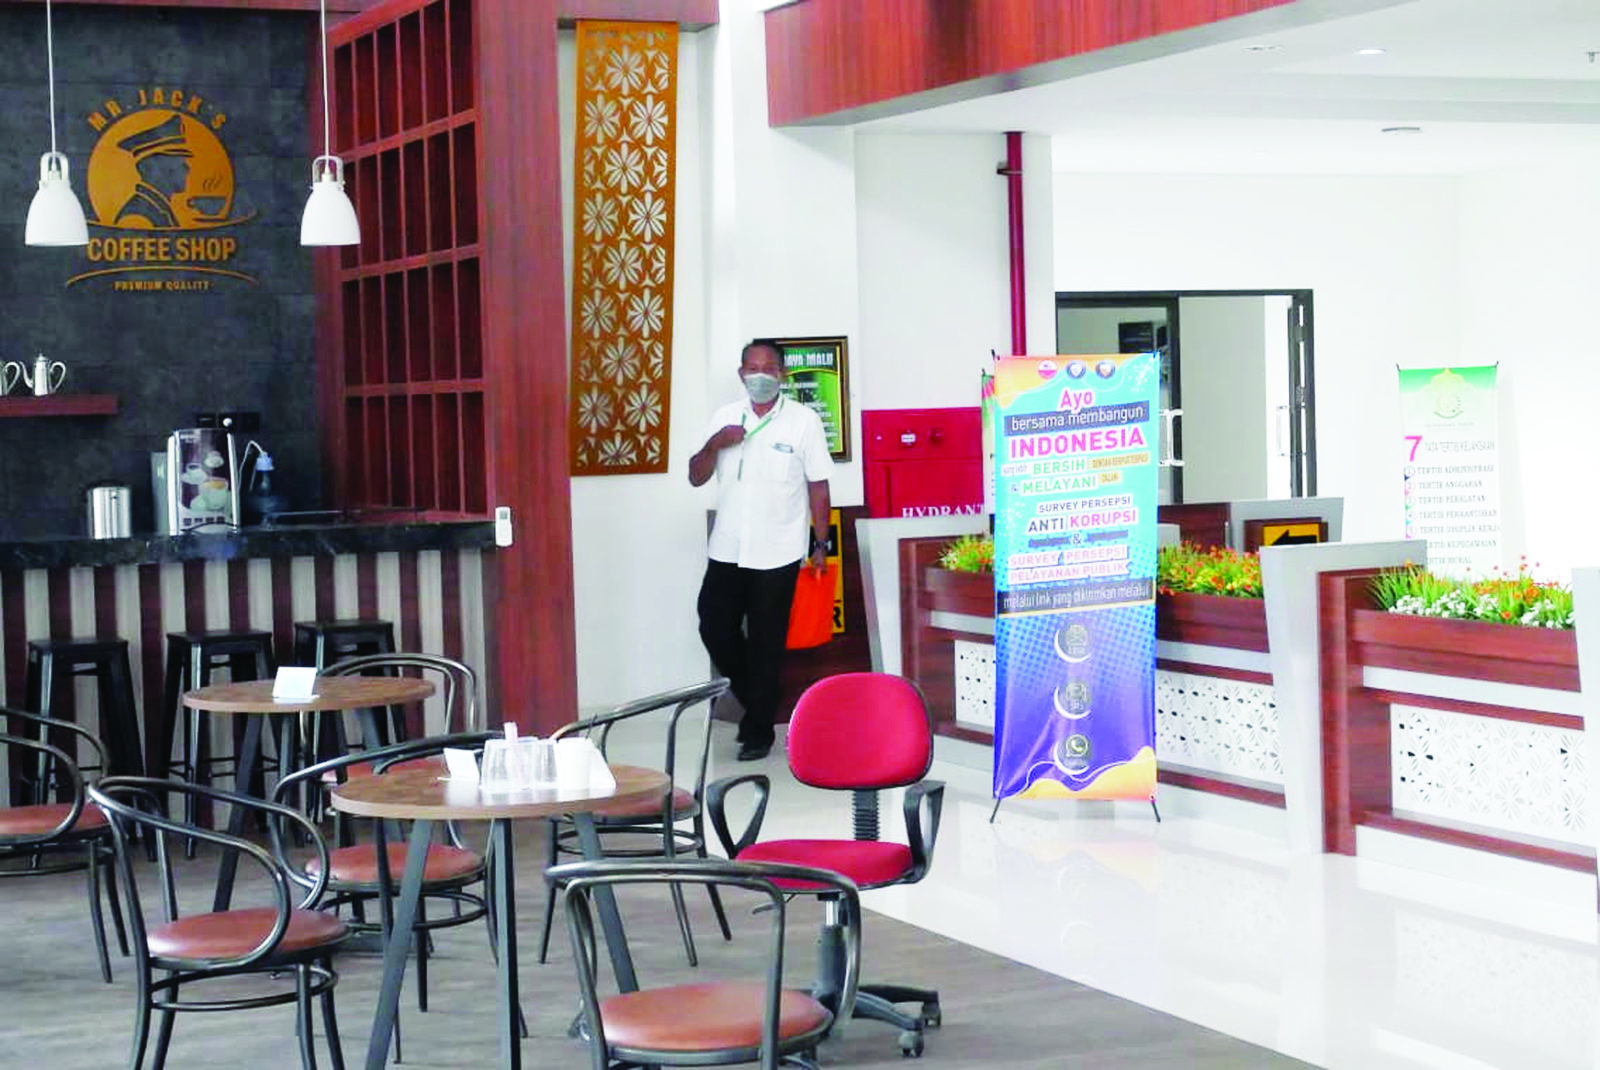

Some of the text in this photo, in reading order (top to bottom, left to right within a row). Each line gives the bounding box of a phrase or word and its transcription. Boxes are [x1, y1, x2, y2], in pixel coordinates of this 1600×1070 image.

[88, 238, 236, 261] COFFEE SHOP
[113, 281, 210, 291] PREMIUM QUALITY
[806, 352, 834, 366] MALU
[1060, 389, 1093, 411] Ayo
[1011, 405, 1144, 432] bersama membangun
[1011, 426, 1145, 459] INDONESIA
[1405, 435, 1423, 462] 7
[1033, 459, 1085, 475] BERSIH
[1023, 476, 1097, 494] MELAYANI
[1039, 496, 1131, 513] SURVEY PERSEPSI
[1028, 509, 1137, 533] ANTI KORUPSI
[1073, 533, 1082, 545] &
[1010, 547, 1126, 566] SURVEY PERSEPSI
[1010, 563, 1125, 581] PELAYANAN PUBLIK
[1050, 592, 1072, 608] yang
